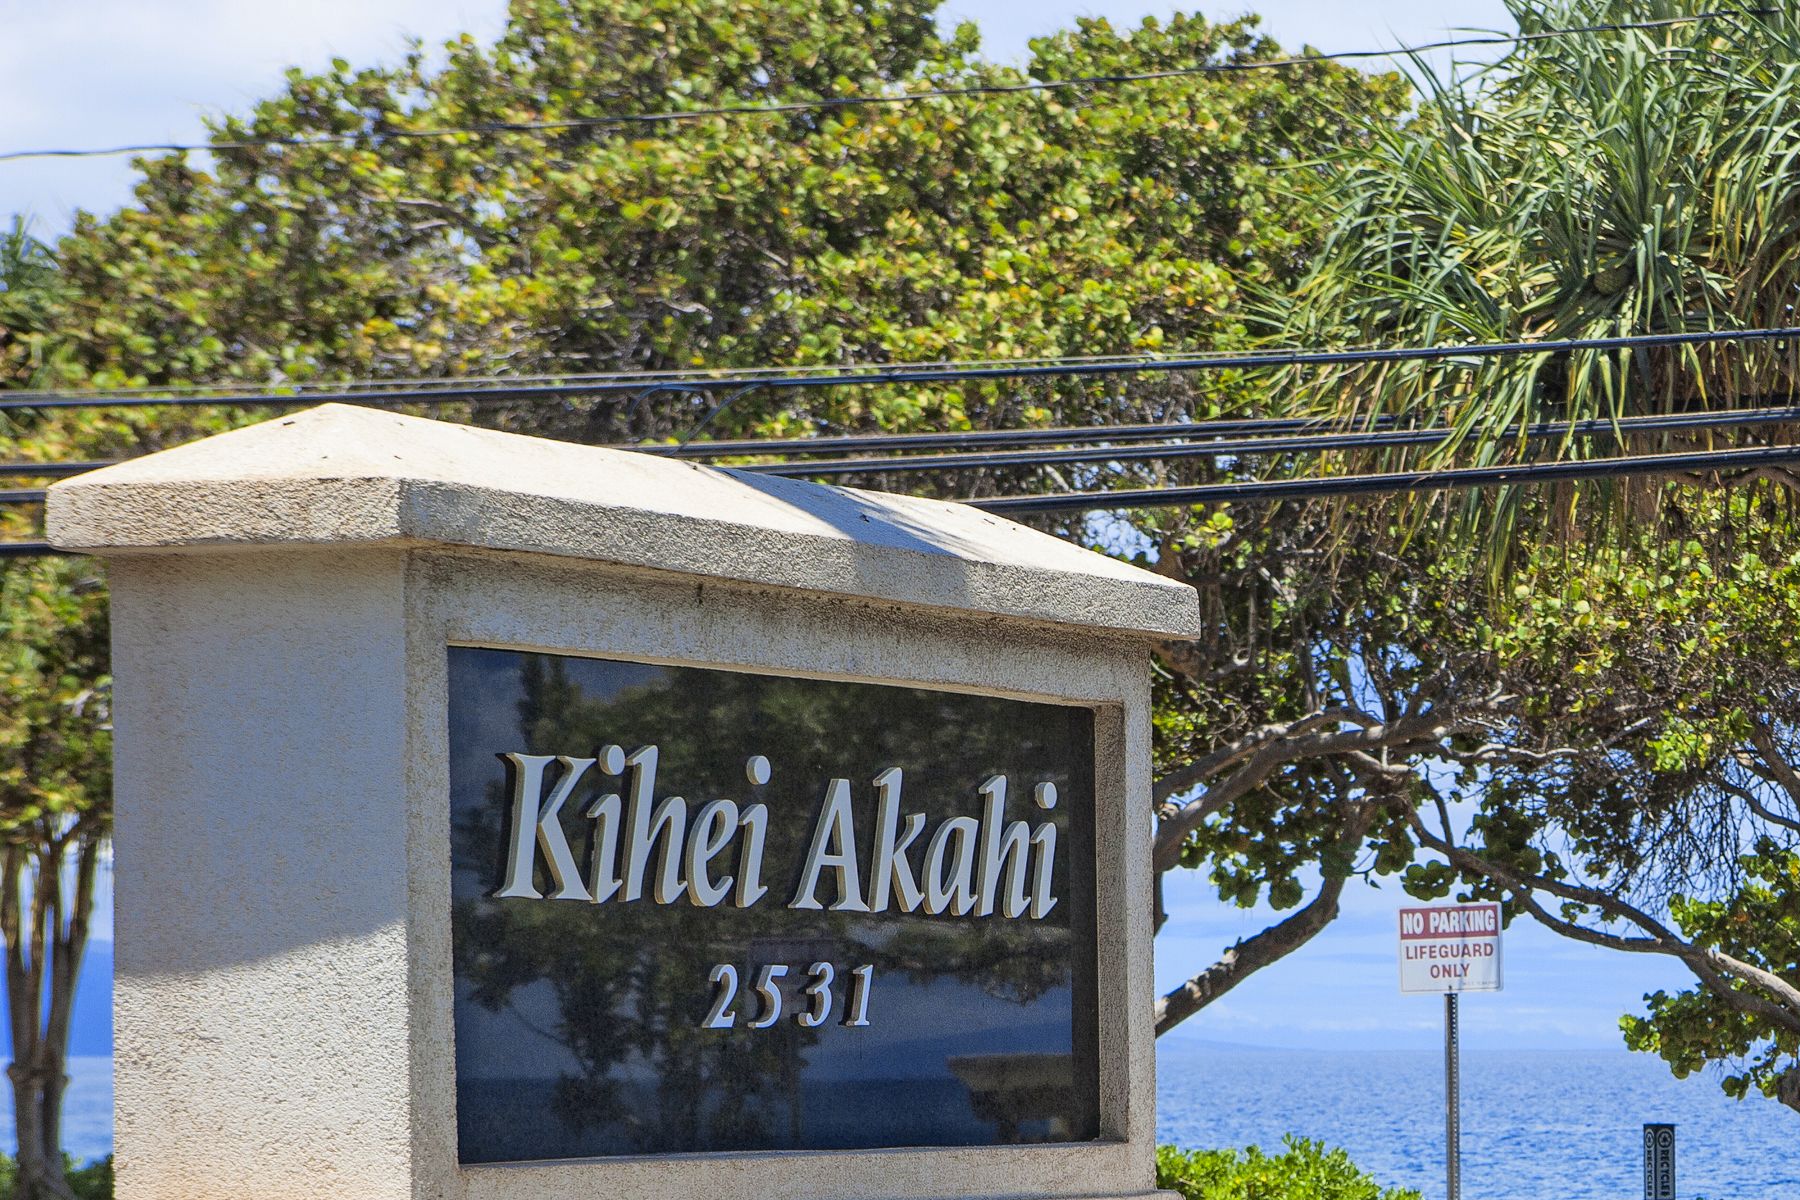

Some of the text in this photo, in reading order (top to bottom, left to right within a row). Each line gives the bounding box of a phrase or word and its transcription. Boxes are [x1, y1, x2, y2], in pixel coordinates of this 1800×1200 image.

[495, 745, 1059, 920] Kihei Akahi
[1402, 909, 1496, 935] NO PARKING
[1405, 942, 1494, 960] LIFEGUARD
[1430, 963, 1470, 979] ONLY
[702, 961, 874, 1029] 2531
